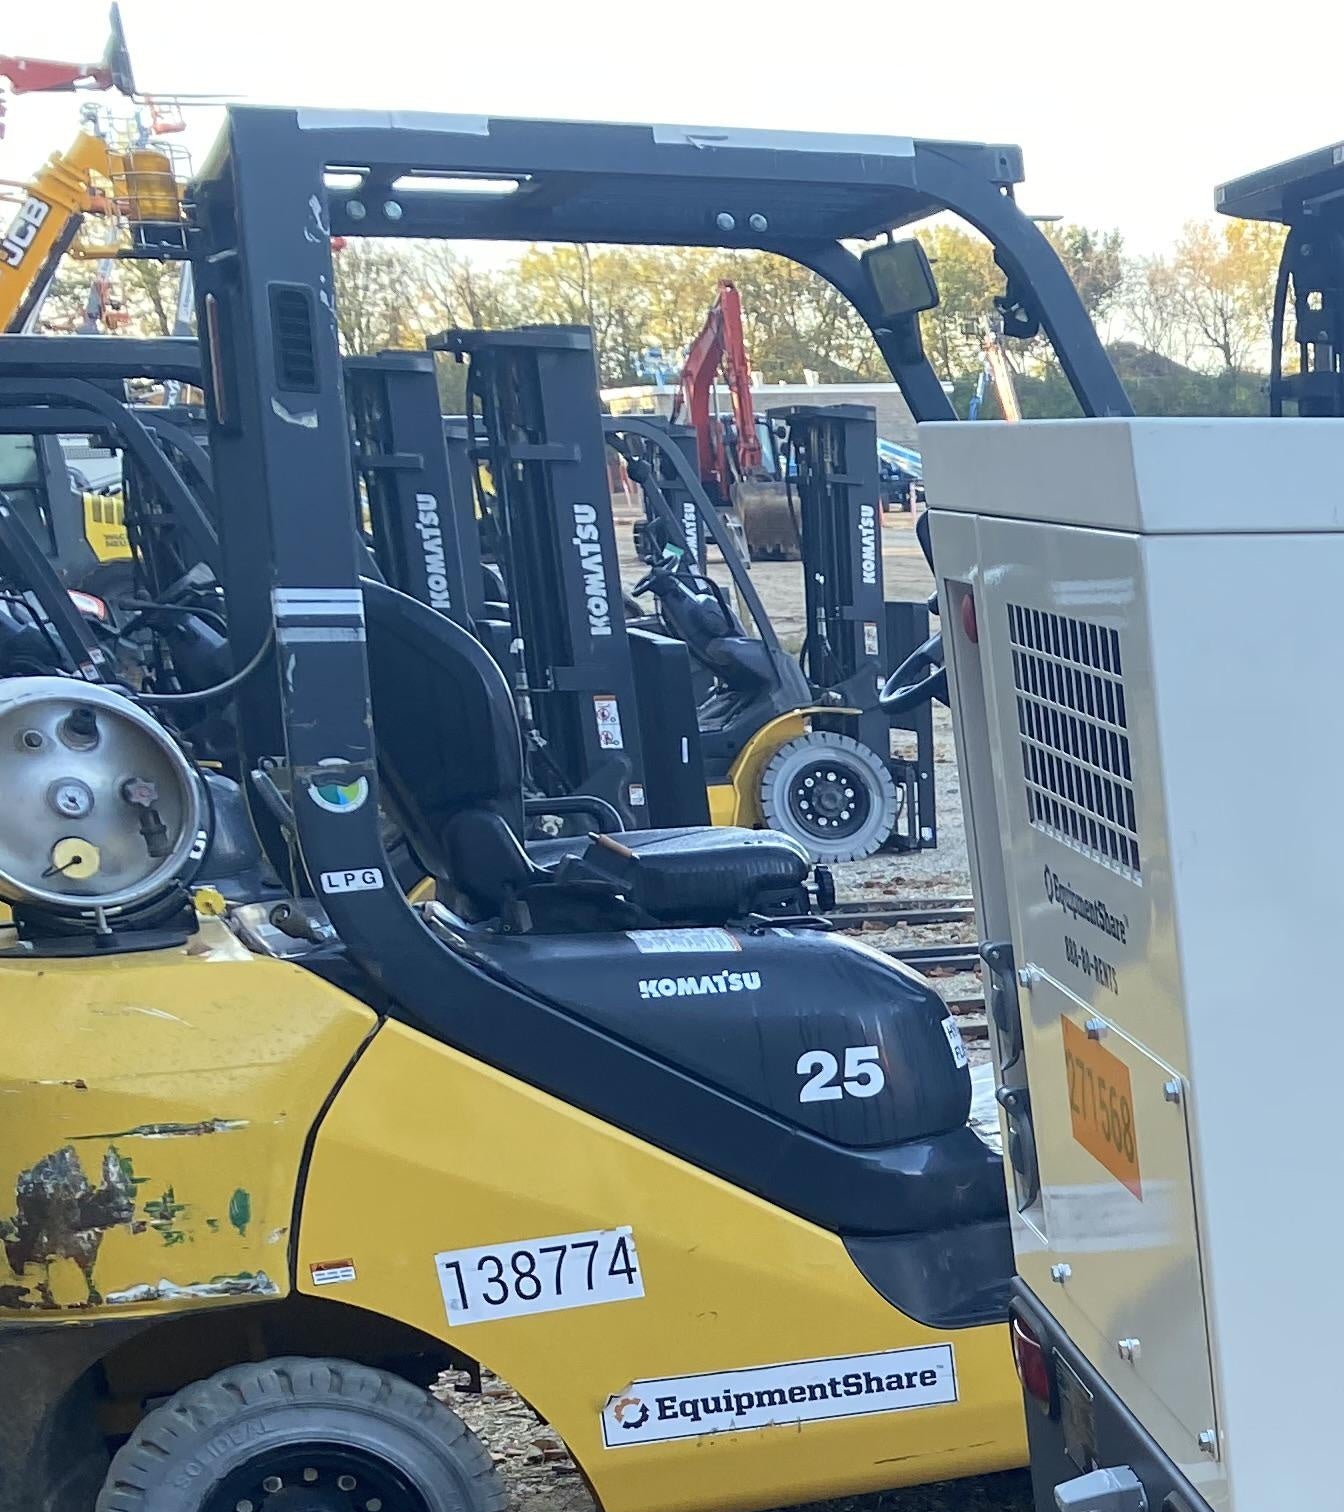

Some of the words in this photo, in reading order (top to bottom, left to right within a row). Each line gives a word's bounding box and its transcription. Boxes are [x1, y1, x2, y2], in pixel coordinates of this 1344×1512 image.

[2, 198, 49, 267] JCB
[415, 493, 451, 609] KOMATSU
[572, 504, 612, 636] KOMATSU
[858, 505, 876, 584] KOMATSU
[638, 970, 762, 999] KOMATSU
[797, 1046, 885, 1103] 25
[1065, 1048, 1135, 1164] 271568
[445, 1236, 637, 1310] 138774
[655, 1368, 938, 1422] EquipmentShare
